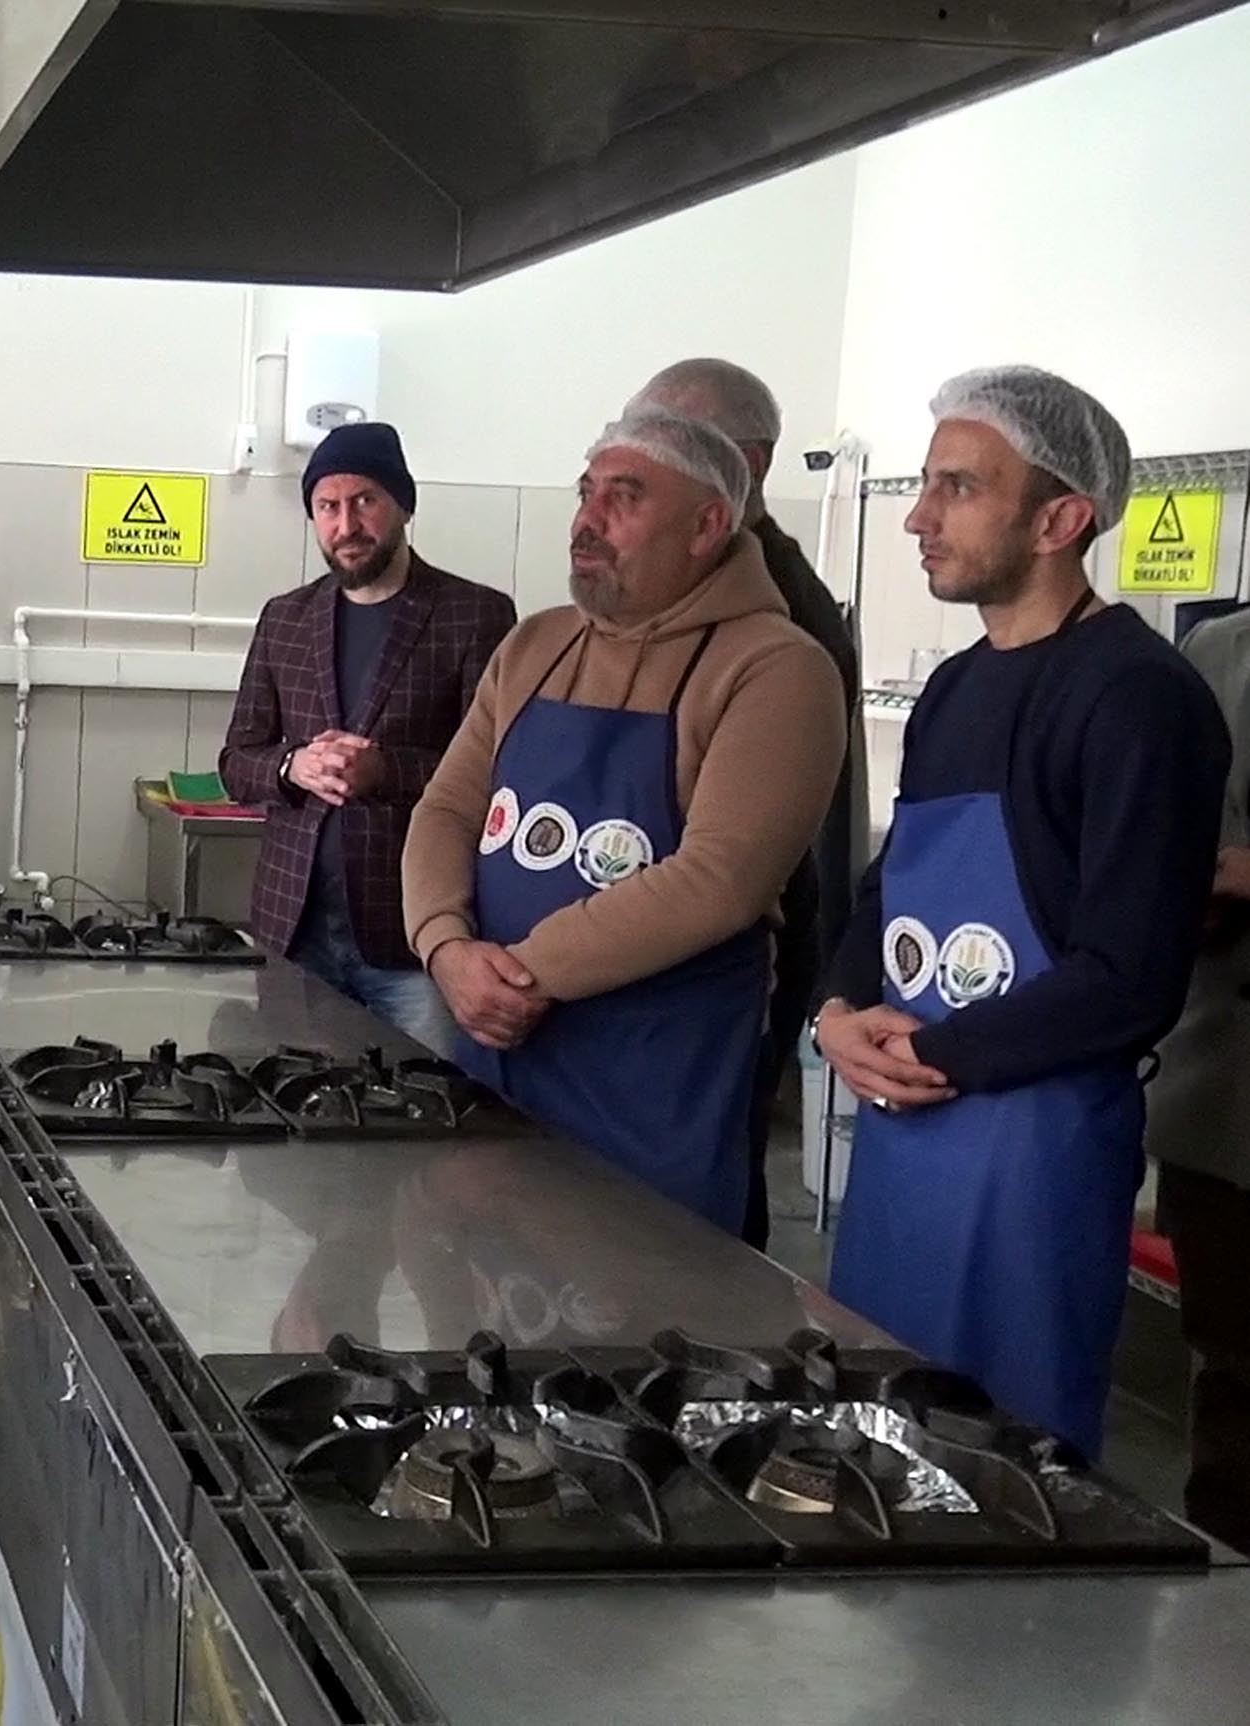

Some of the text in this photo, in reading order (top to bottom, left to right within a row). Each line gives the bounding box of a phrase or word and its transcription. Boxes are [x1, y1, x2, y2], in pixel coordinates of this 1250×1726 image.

[107, 527, 180, 541] ISLAK ZEMİN
[105, 540, 181, 556] DİKKATLİ OL!
